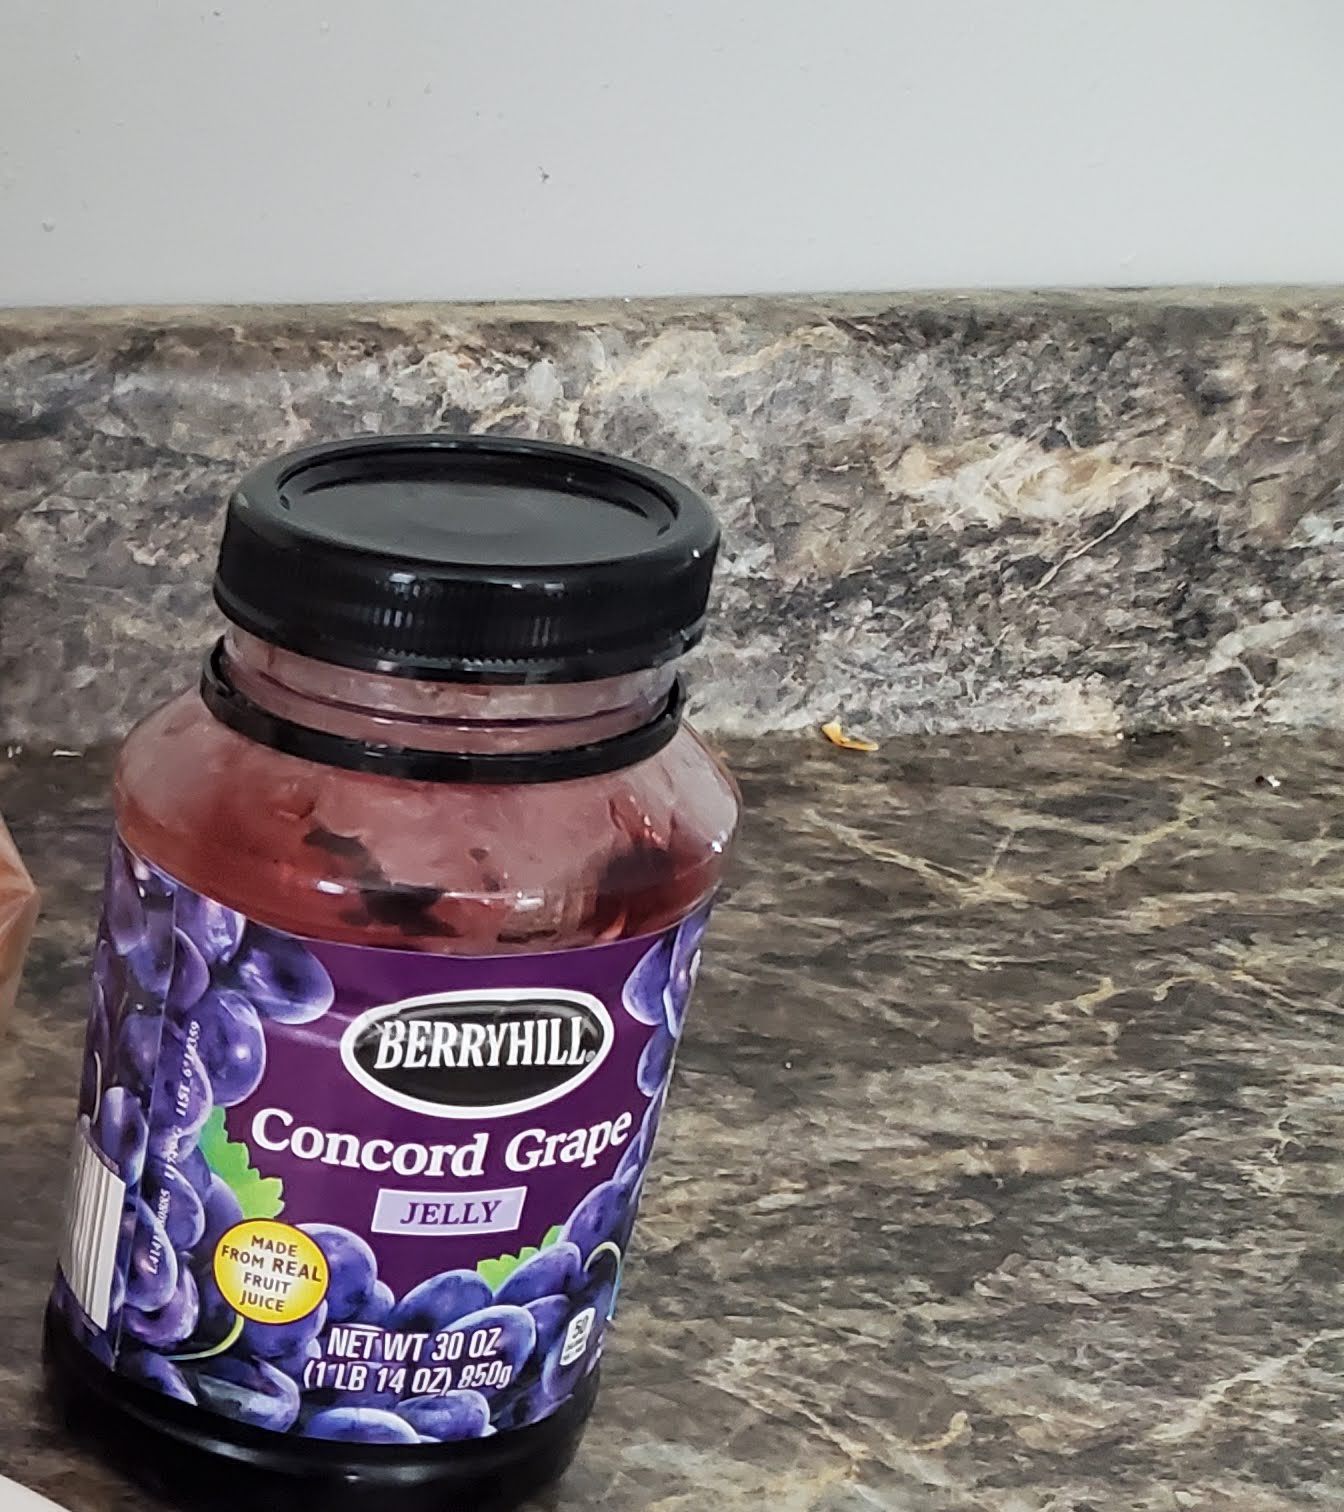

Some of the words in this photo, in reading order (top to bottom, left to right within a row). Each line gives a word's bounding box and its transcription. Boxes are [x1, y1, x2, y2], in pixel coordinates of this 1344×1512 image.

[373, 1015, 587, 1070] BERRYHILL
[251, 1107, 490, 1178] Concord
[504, 1111, 633, 1172] Grape
[399, 1199, 503, 1225] JELLY
[250, 1234, 299, 1258] MADE
[221, 1245, 265, 1270] FROM
[272, 1257, 323, 1283] REAL
[243, 1271, 292, 1296] FRUIT
[239, 1290, 286, 1314] JUICE
[327, 1327, 381, 1360] NET
[383, 1331, 431, 1362] WT
[431, 1331, 465, 1361] 30
[468, 1327, 504, 1358] OZ
[303, 1358, 329, 1391] (1
[336, 1363, 368, 1393] LB
[377, 1367, 405, 1395] 14
[411, 1364, 452, 1398] OZ)
[457, 1359, 513, 1392] 850g
